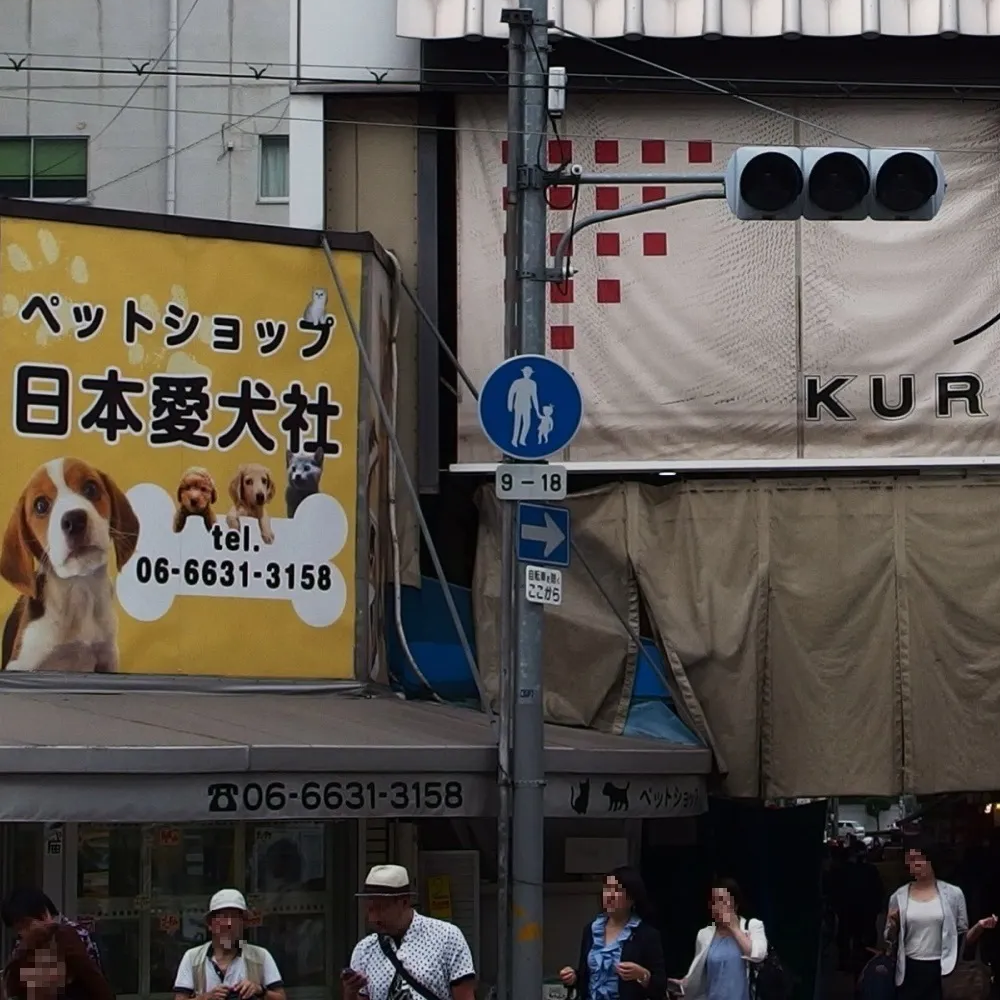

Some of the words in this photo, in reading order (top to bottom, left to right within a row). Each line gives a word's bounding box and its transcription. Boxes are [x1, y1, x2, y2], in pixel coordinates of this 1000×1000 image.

[21, 295, 335, 358] ペットショップ
[15, 364, 341, 456] 日本愛犬社
[211, 526, 260, 553] tel.
[136, 556, 332, 591] 06-6631-3158
[528, 581, 560, 600] ここから
[242, 781, 464, 811] 06-6631-3158
